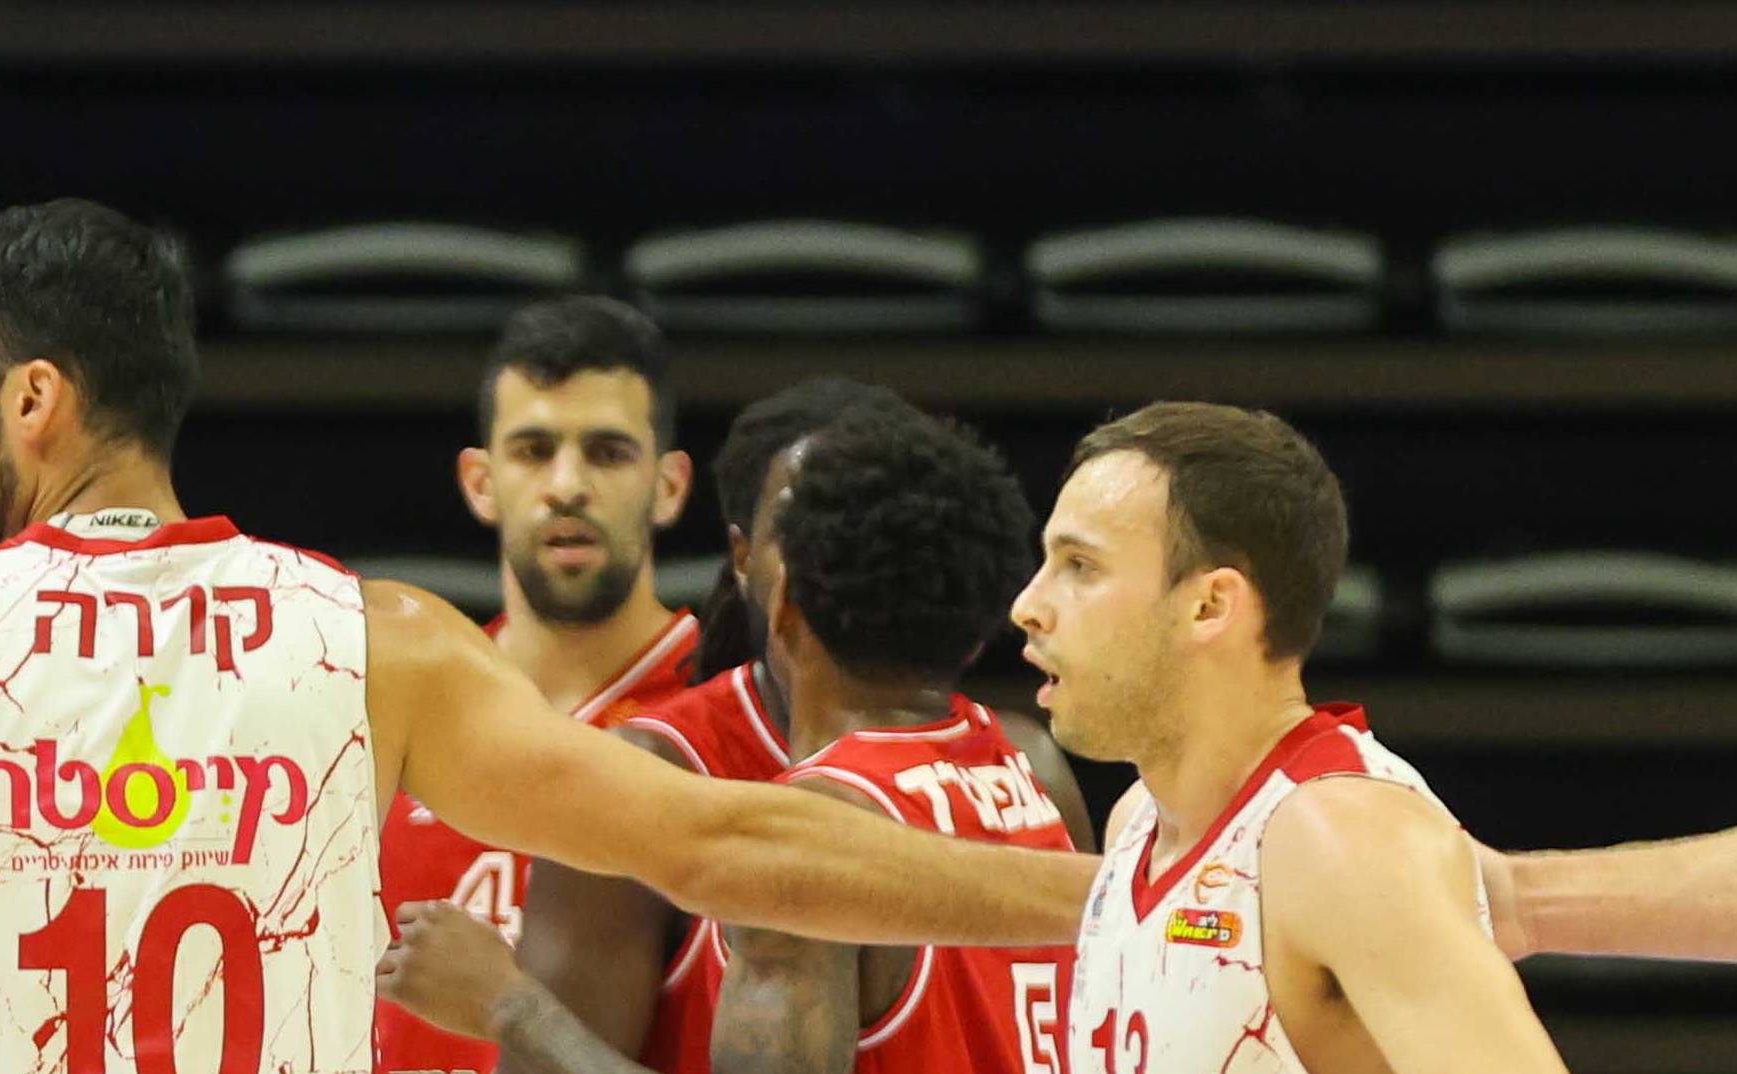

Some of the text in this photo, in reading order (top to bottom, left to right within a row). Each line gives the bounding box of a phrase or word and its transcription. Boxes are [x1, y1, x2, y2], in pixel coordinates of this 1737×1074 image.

[90, 515, 143, 528] NIKE
[127, 852, 173, 870] פירות
[181, 850, 229, 870] שיווק
[449, 850, 524, 951] 4
